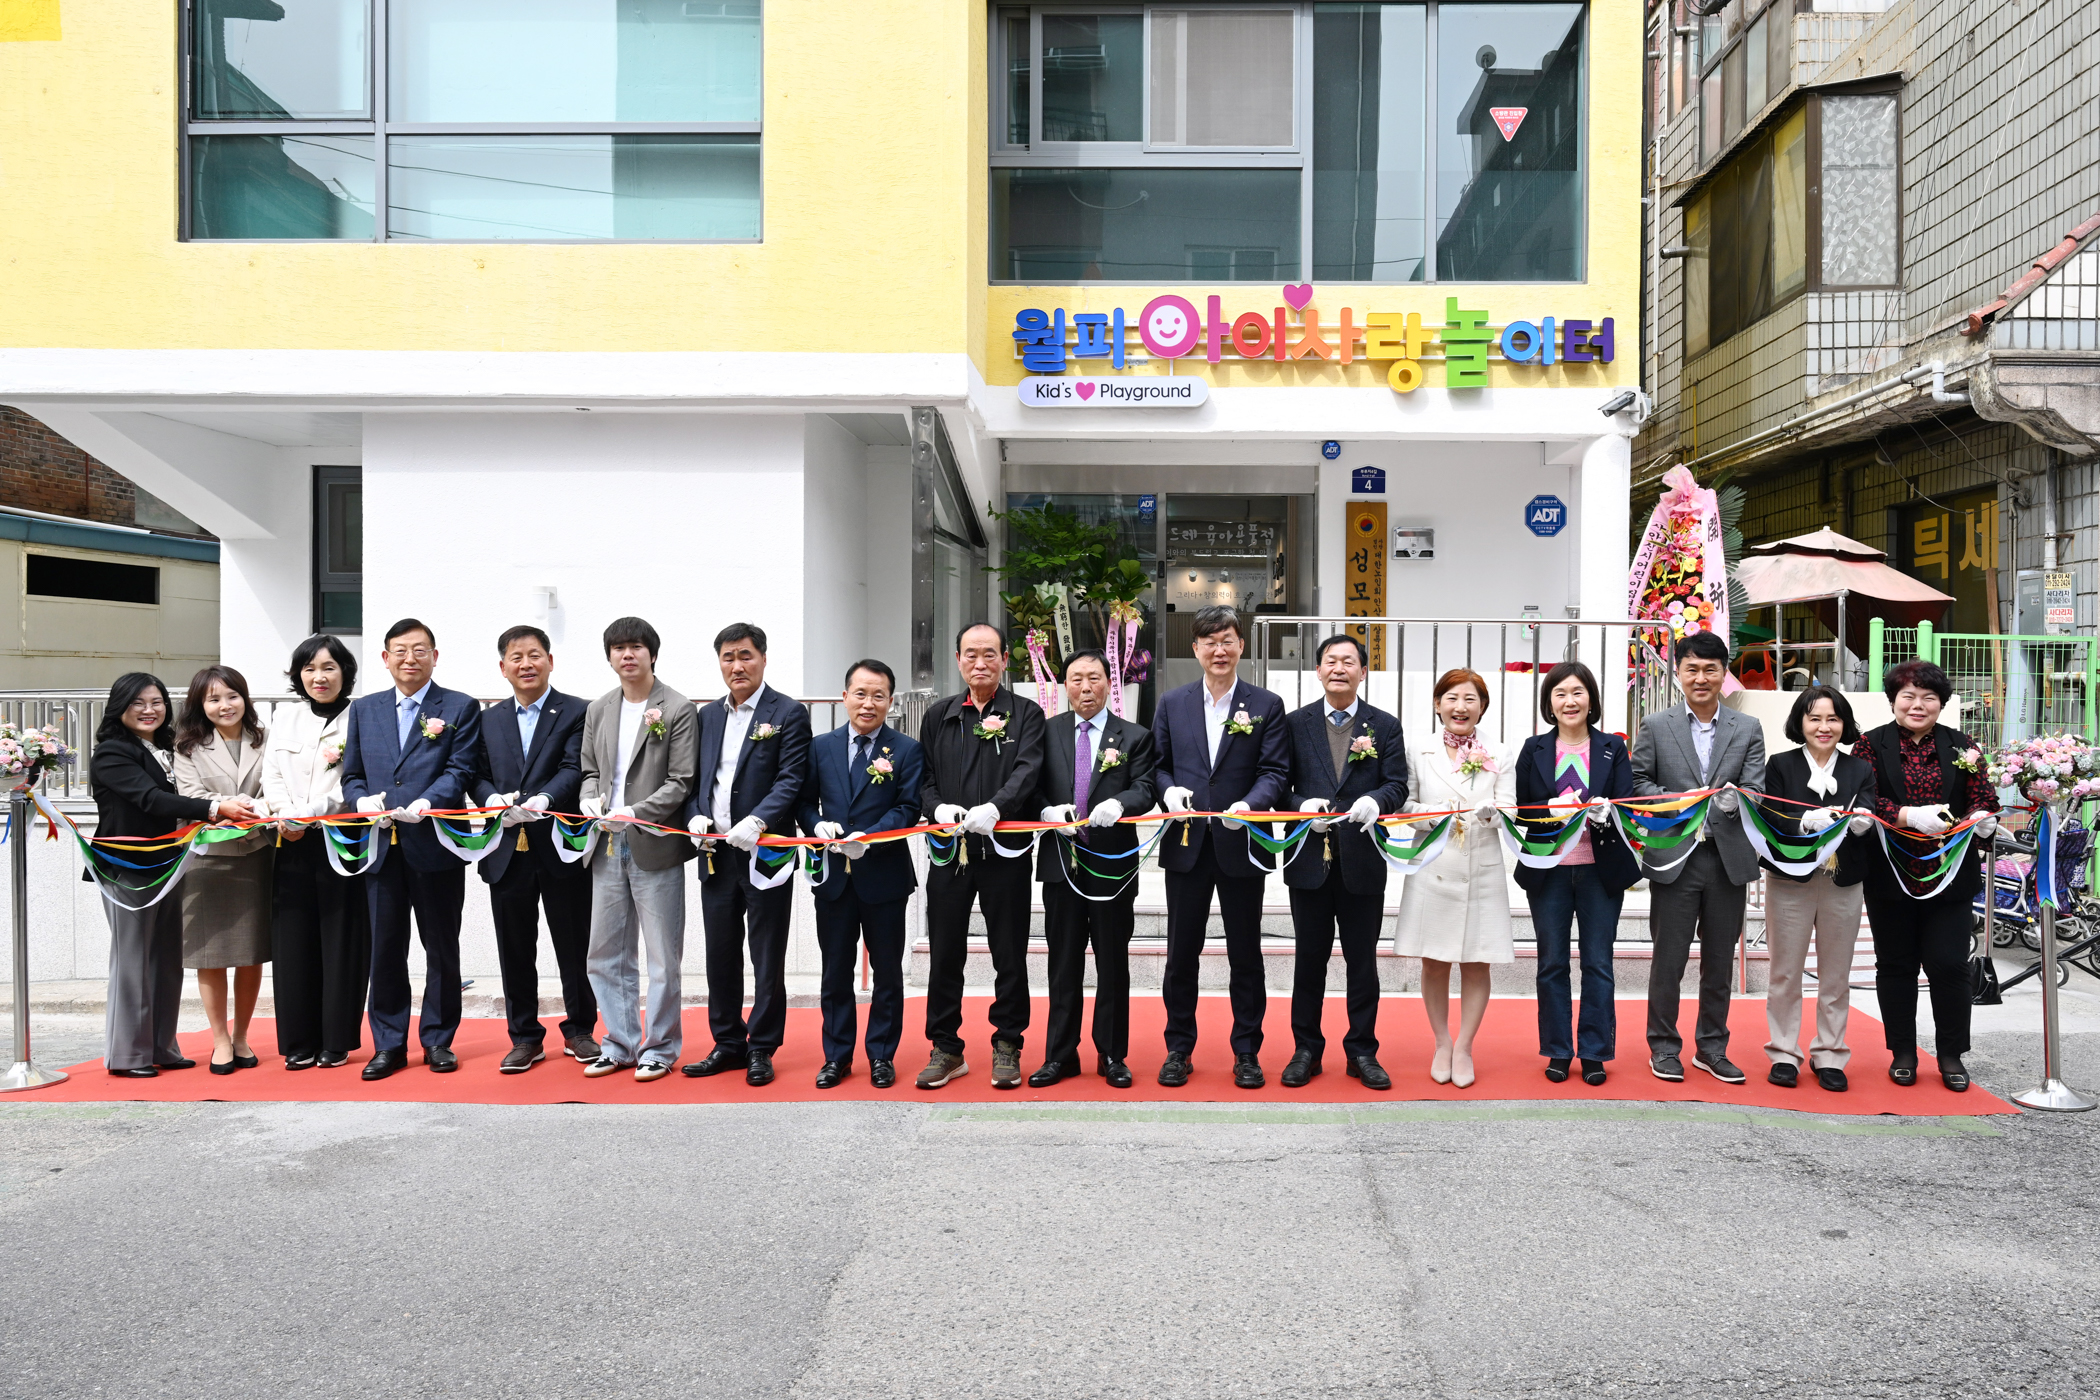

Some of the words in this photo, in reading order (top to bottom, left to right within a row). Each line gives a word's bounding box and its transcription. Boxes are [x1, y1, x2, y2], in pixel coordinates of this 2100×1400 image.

[1012, 307, 1125, 373] 월피
[1139, 295, 1614, 393] 아이사랑놀이터
[1036, 382, 1071, 398] Kid's
[1100, 383, 1191, 401] Playground
[1364, 479, 1372, 490] 4
[1140, 500, 1154, 508] ADT
[1531, 508, 1560, 522] ADT
[1206, 524, 1274, 546] 육아용품점
[2049, 608, 2072, 616] 사다리차
